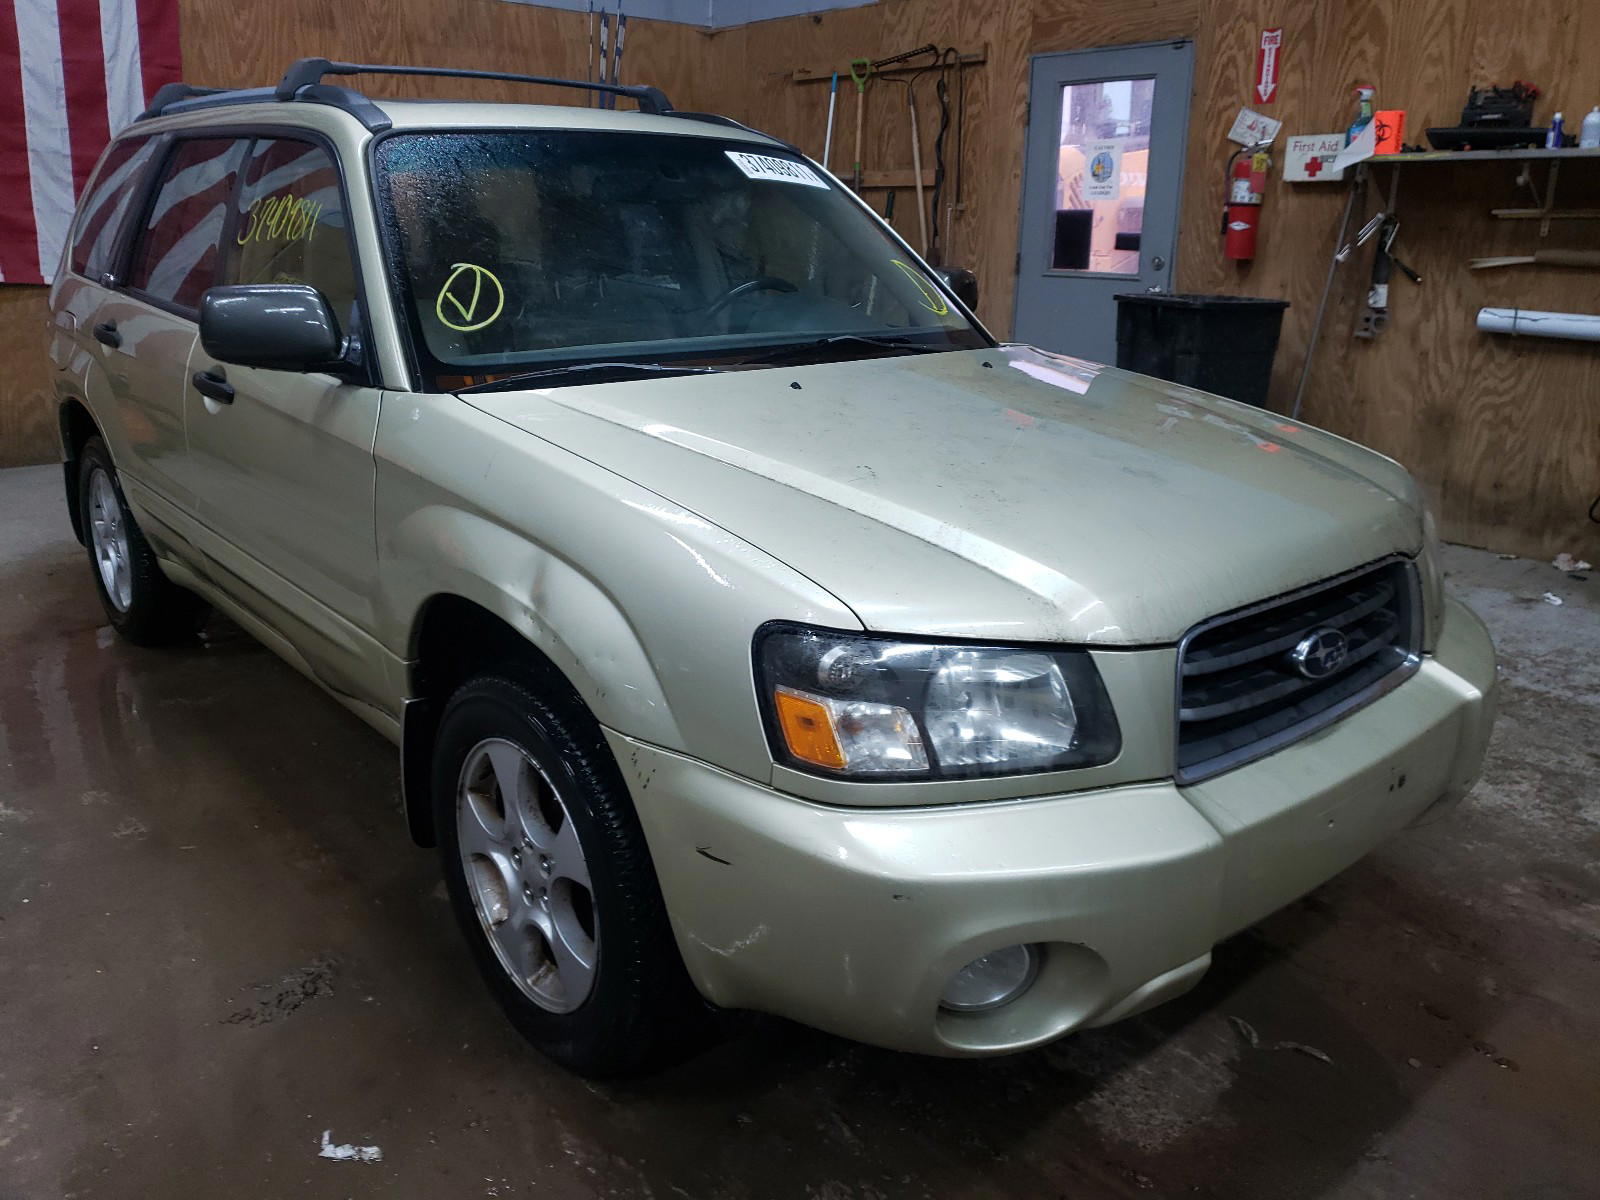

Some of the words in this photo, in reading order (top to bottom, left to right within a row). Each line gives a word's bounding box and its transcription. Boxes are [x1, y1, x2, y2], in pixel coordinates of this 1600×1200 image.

[1293, 140, 1315, 152] First
[1319, 140, 1339, 152] Aid
[738, 153, 813, 181] 37409811
